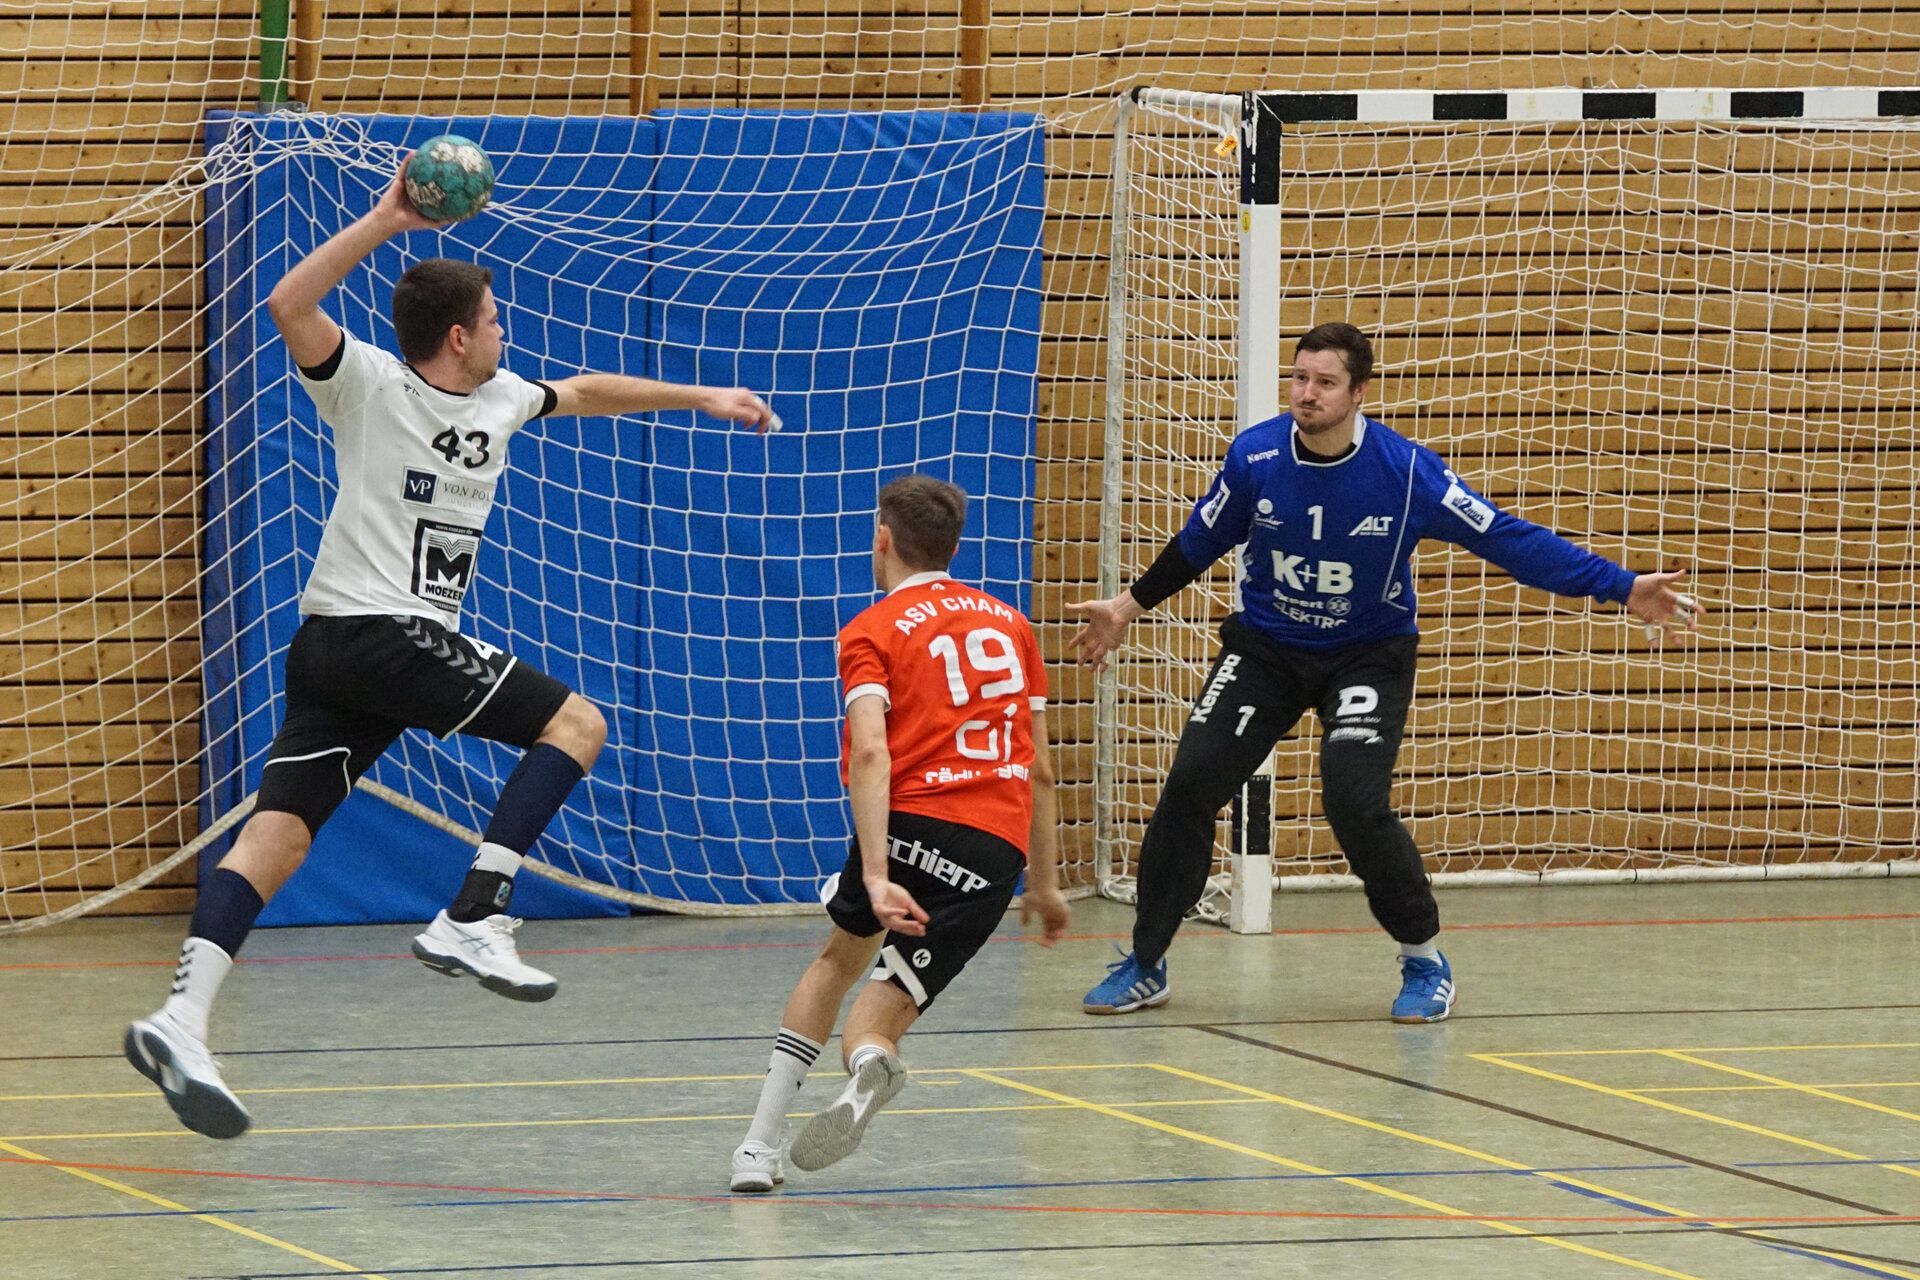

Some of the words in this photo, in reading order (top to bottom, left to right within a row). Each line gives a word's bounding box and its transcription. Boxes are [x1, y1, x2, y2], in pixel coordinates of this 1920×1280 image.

[431, 425, 490, 469] 43
[410, 478, 432, 496] VP
[444, 482, 470, 497] VON
[1307, 504, 1324, 541] 1
[1348, 515, 1394, 537] ALT
[895, 600, 938, 637] ASV
[941, 596, 1013, 623] CHAM
[928, 627, 1025, 707] 19
[1189, 653, 1242, 724] Kempa
[1234, 704, 1257, 737] 1
